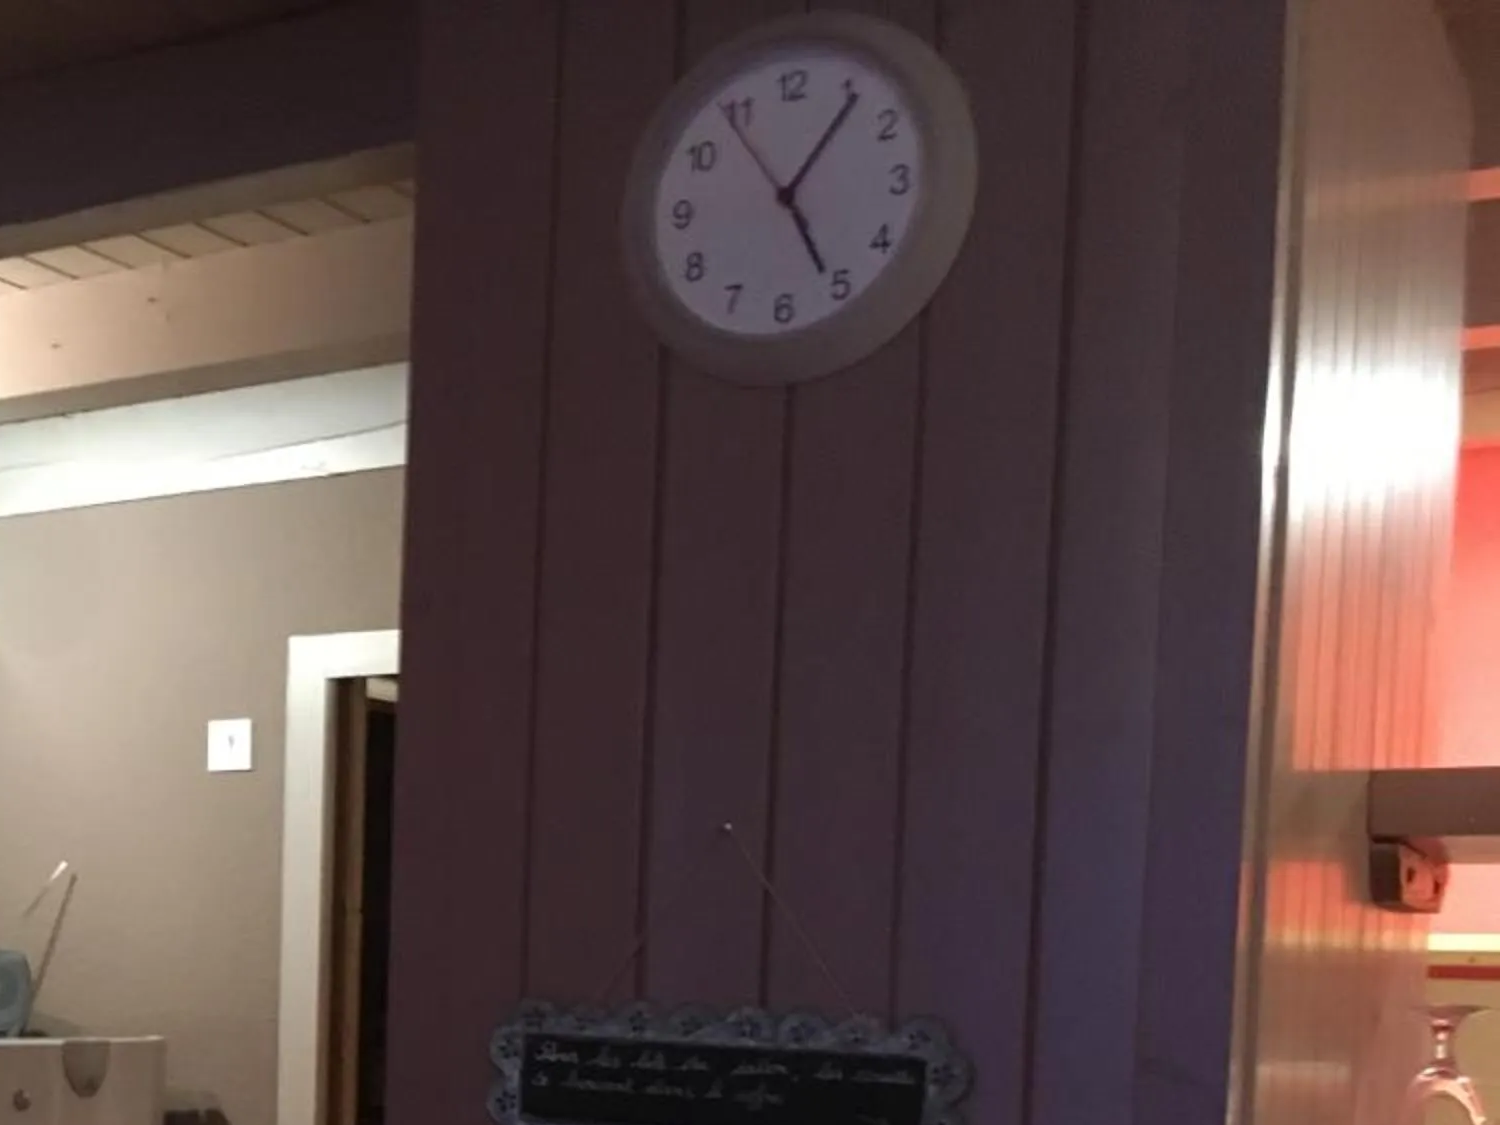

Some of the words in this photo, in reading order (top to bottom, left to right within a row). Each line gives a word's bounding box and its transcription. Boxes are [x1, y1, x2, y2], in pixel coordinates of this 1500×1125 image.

[777, 70, 808, 102] 12
[725, 96, 756, 127] 11
[878, 109, 898, 141] 2
[686, 141, 716, 171] 10
[889, 164, 910, 195] 3
[672, 200, 693, 229] 9
[869, 223, 891, 254] 4
[685, 252, 704, 282] 8
[724, 284, 744, 314] 7
[831, 269, 851, 300] 5
[774, 293, 794, 323] 6
